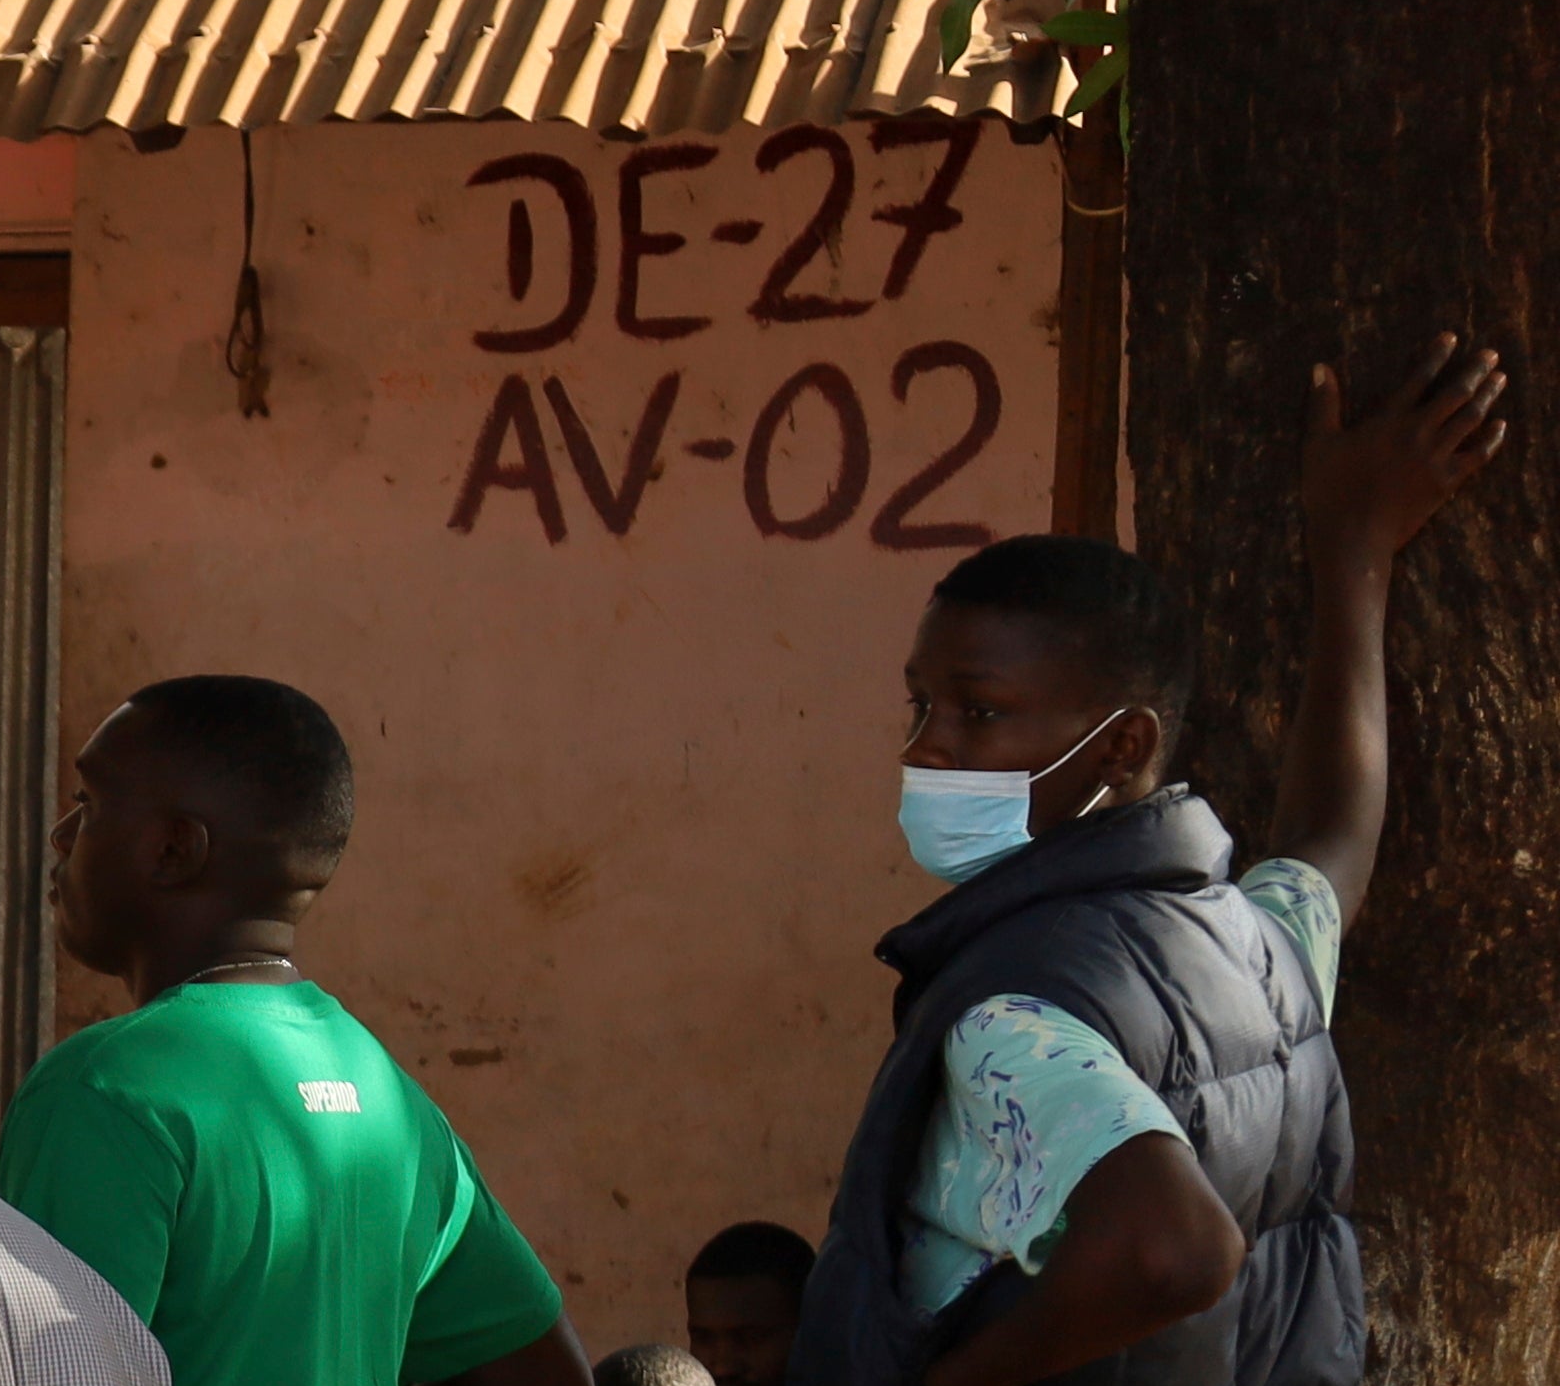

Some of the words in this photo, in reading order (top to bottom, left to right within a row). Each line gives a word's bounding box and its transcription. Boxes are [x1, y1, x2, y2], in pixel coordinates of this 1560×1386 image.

[465, 120, 983, 354] DE-27
[447, 341, 1002, 550] AV-02
[297, 1080, 361, 1113] SUPERIOR
